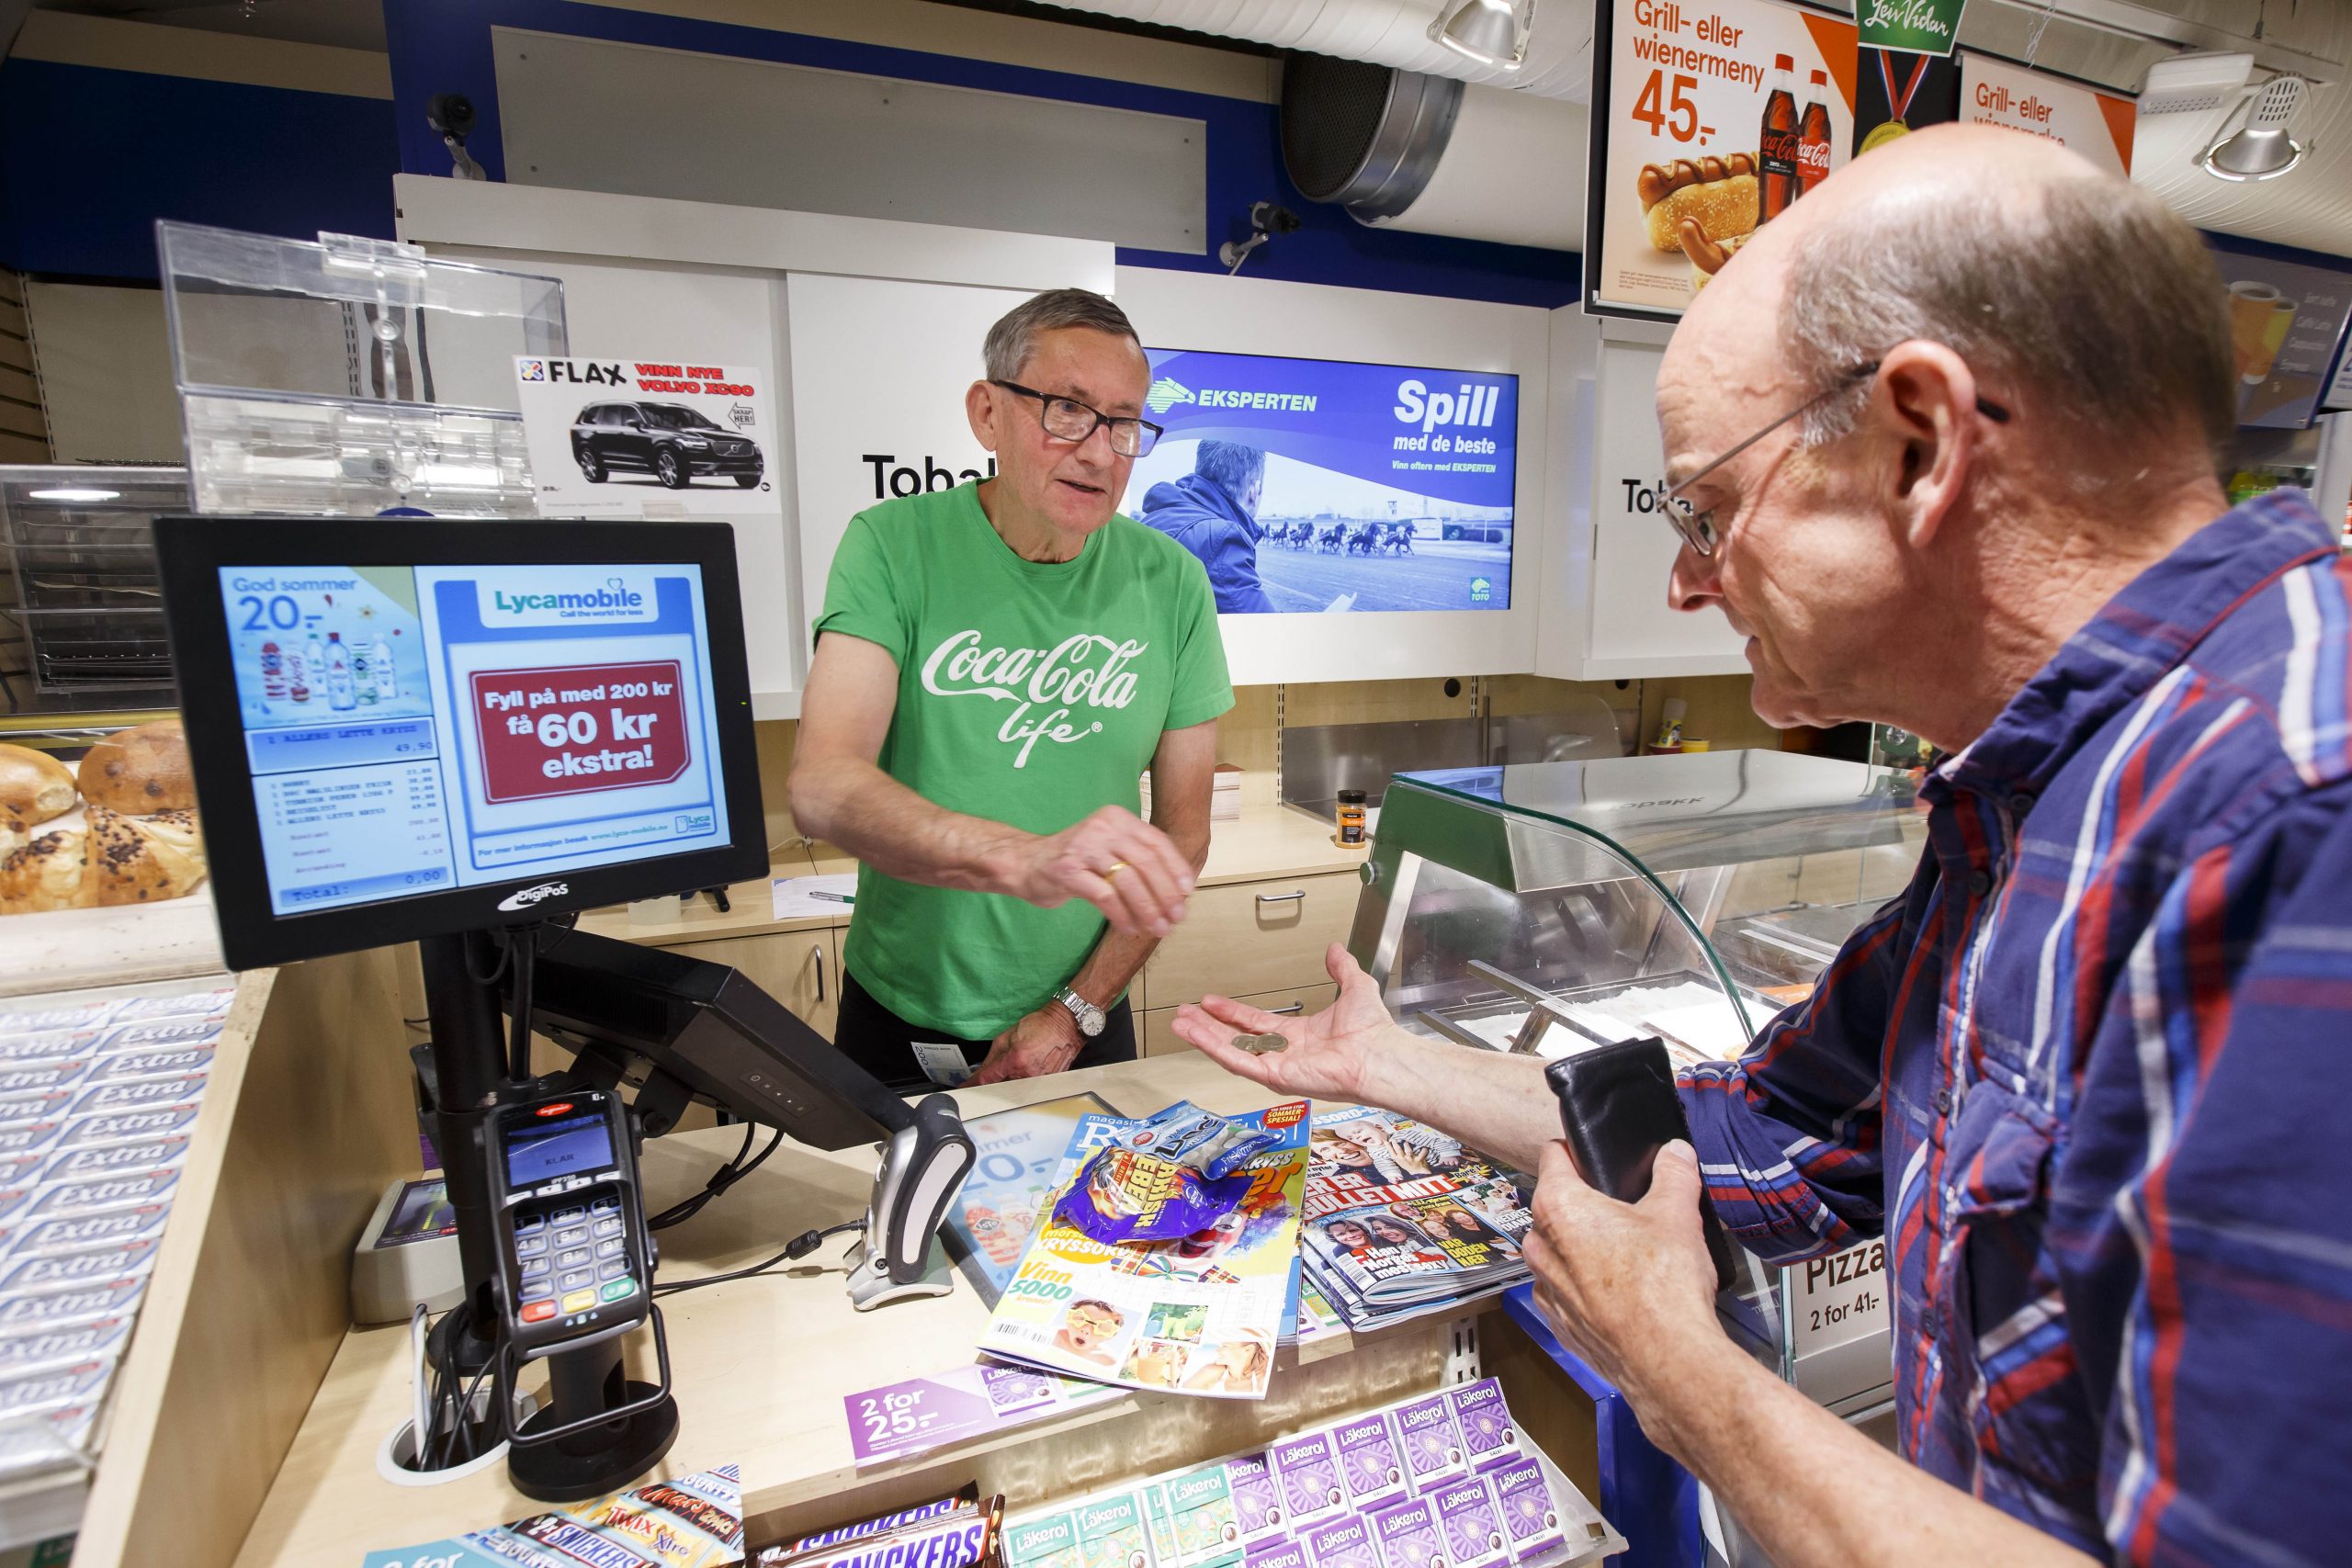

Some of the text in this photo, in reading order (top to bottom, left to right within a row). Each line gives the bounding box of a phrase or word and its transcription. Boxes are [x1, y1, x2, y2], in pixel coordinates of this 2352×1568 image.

[1634, 0, 1743, 48] Grill- eller
[1634, 33, 1765, 93] wienermeny
[1975, 83, 2052, 123] Grill- eller
[549, 361, 627, 386] FLAX
[635, 363, 723, 380] VINN NYE
[638, 379, 754, 396] VOLVO XC90
[1198, 389, 1317, 412] EKSPERTEN
[1393, 378, 1499, 434] Spill
[735, 415, 753, 423] HER!
[1393, 434, 1496, 456] med de beste
[1391, 459, 1497, 473] Vinn oftere med EKSPERTEN
[233, 578, 357, 592] God sommer
[1471, 592, 1490, 603] TOTO
[495, 588, 643, 614] Lycamobile
[560, 610, 575, 618] Call
[592, 609, 616, 617] world
[616, 608, 627, 616] for
[628, 608, 643, 616] less
[921, 629, 1149, 710] Coca-Cola
[485, 682, 673, 711] Fyll på med 200 kr
[507, 707, 658, 748] få 60 kr
[542, 744, 654, 779] ekstra!
[292, 886, 349, 901] Total:
[119, 1022, 209, 1043] Extra
[108, 1050, 200, 1073] Extra
[915, 1045, 928, 1066] 200
[95, 1079, 189, 1103] Extra
[81, 1111, 178, 1135] Extra
[1266, 1115, 1301, 1124] SPESIAL!
[1267, 1109, 1305, 1119] SOMMER-
[68, 1145, 168, 1169] Extra
[545, 1154, 574, 1166] KLAR
[51, 1178, 156, 1207] Extra
[1330, 1172, 1372, 1190] ER
[1305, 1173, 1454, 1220] GULLET MITT
[37, 1214, 142, 1244] Extra
[518, 1221, 610, 1249] 4 5 6
[562, 1253, 573, 1262] 8
[603, 1242, 614, 1251] 9
[1363, 1247, 1400, 1259] Han
[1437, 1238, 1466, 1249] VAR
[1446, 1243, 1491, 1258] DØDEN
[20, 1251, 131, 1281] Extra
[1019, 1262, 1073, 1284] Vinn
[1362, 1253, 1420, 1271] Norges
[1455, 1255, 1490, 1268] NÆR
[1806, 1242, 1885, 1295] Pizza
[1008, 1280, 1073, 1301] 5000
[3, 1290, 117, 1322] Extra
[1810, 1310, 1821, 1332] 2
[1825, 1303, 1850, 1325] for
[860, 1389, 925, 1418] 2 for
[1457, 1385, 1498, 1409] Läkerol
[1402, 1404, 1445, 1428] Läkerol
[1340, 1421, 1384, 1448] Läkerol
[1281, 1440, 1326, 1467] Läkerol
[1173, 1474, 1223, 1504] Läkerol
[1498, 1465, 1540, 1494] Läkerol
[642, 1484, 709, 1514] Mars
[1441, 1485, 1485, 1512] Läkerol
[607, 1506, 656, 1538] TWIX
[1080, 1502, 1132, 1532] Läkerol
[1382, 1507, 1428, 1536] Läkerol
[549, 1525, 641, 1568] SNICKERS
[1015, 1523, 1069, 1553] Läkerol
[1316, 1523, 1363, 1554] Läkerol
